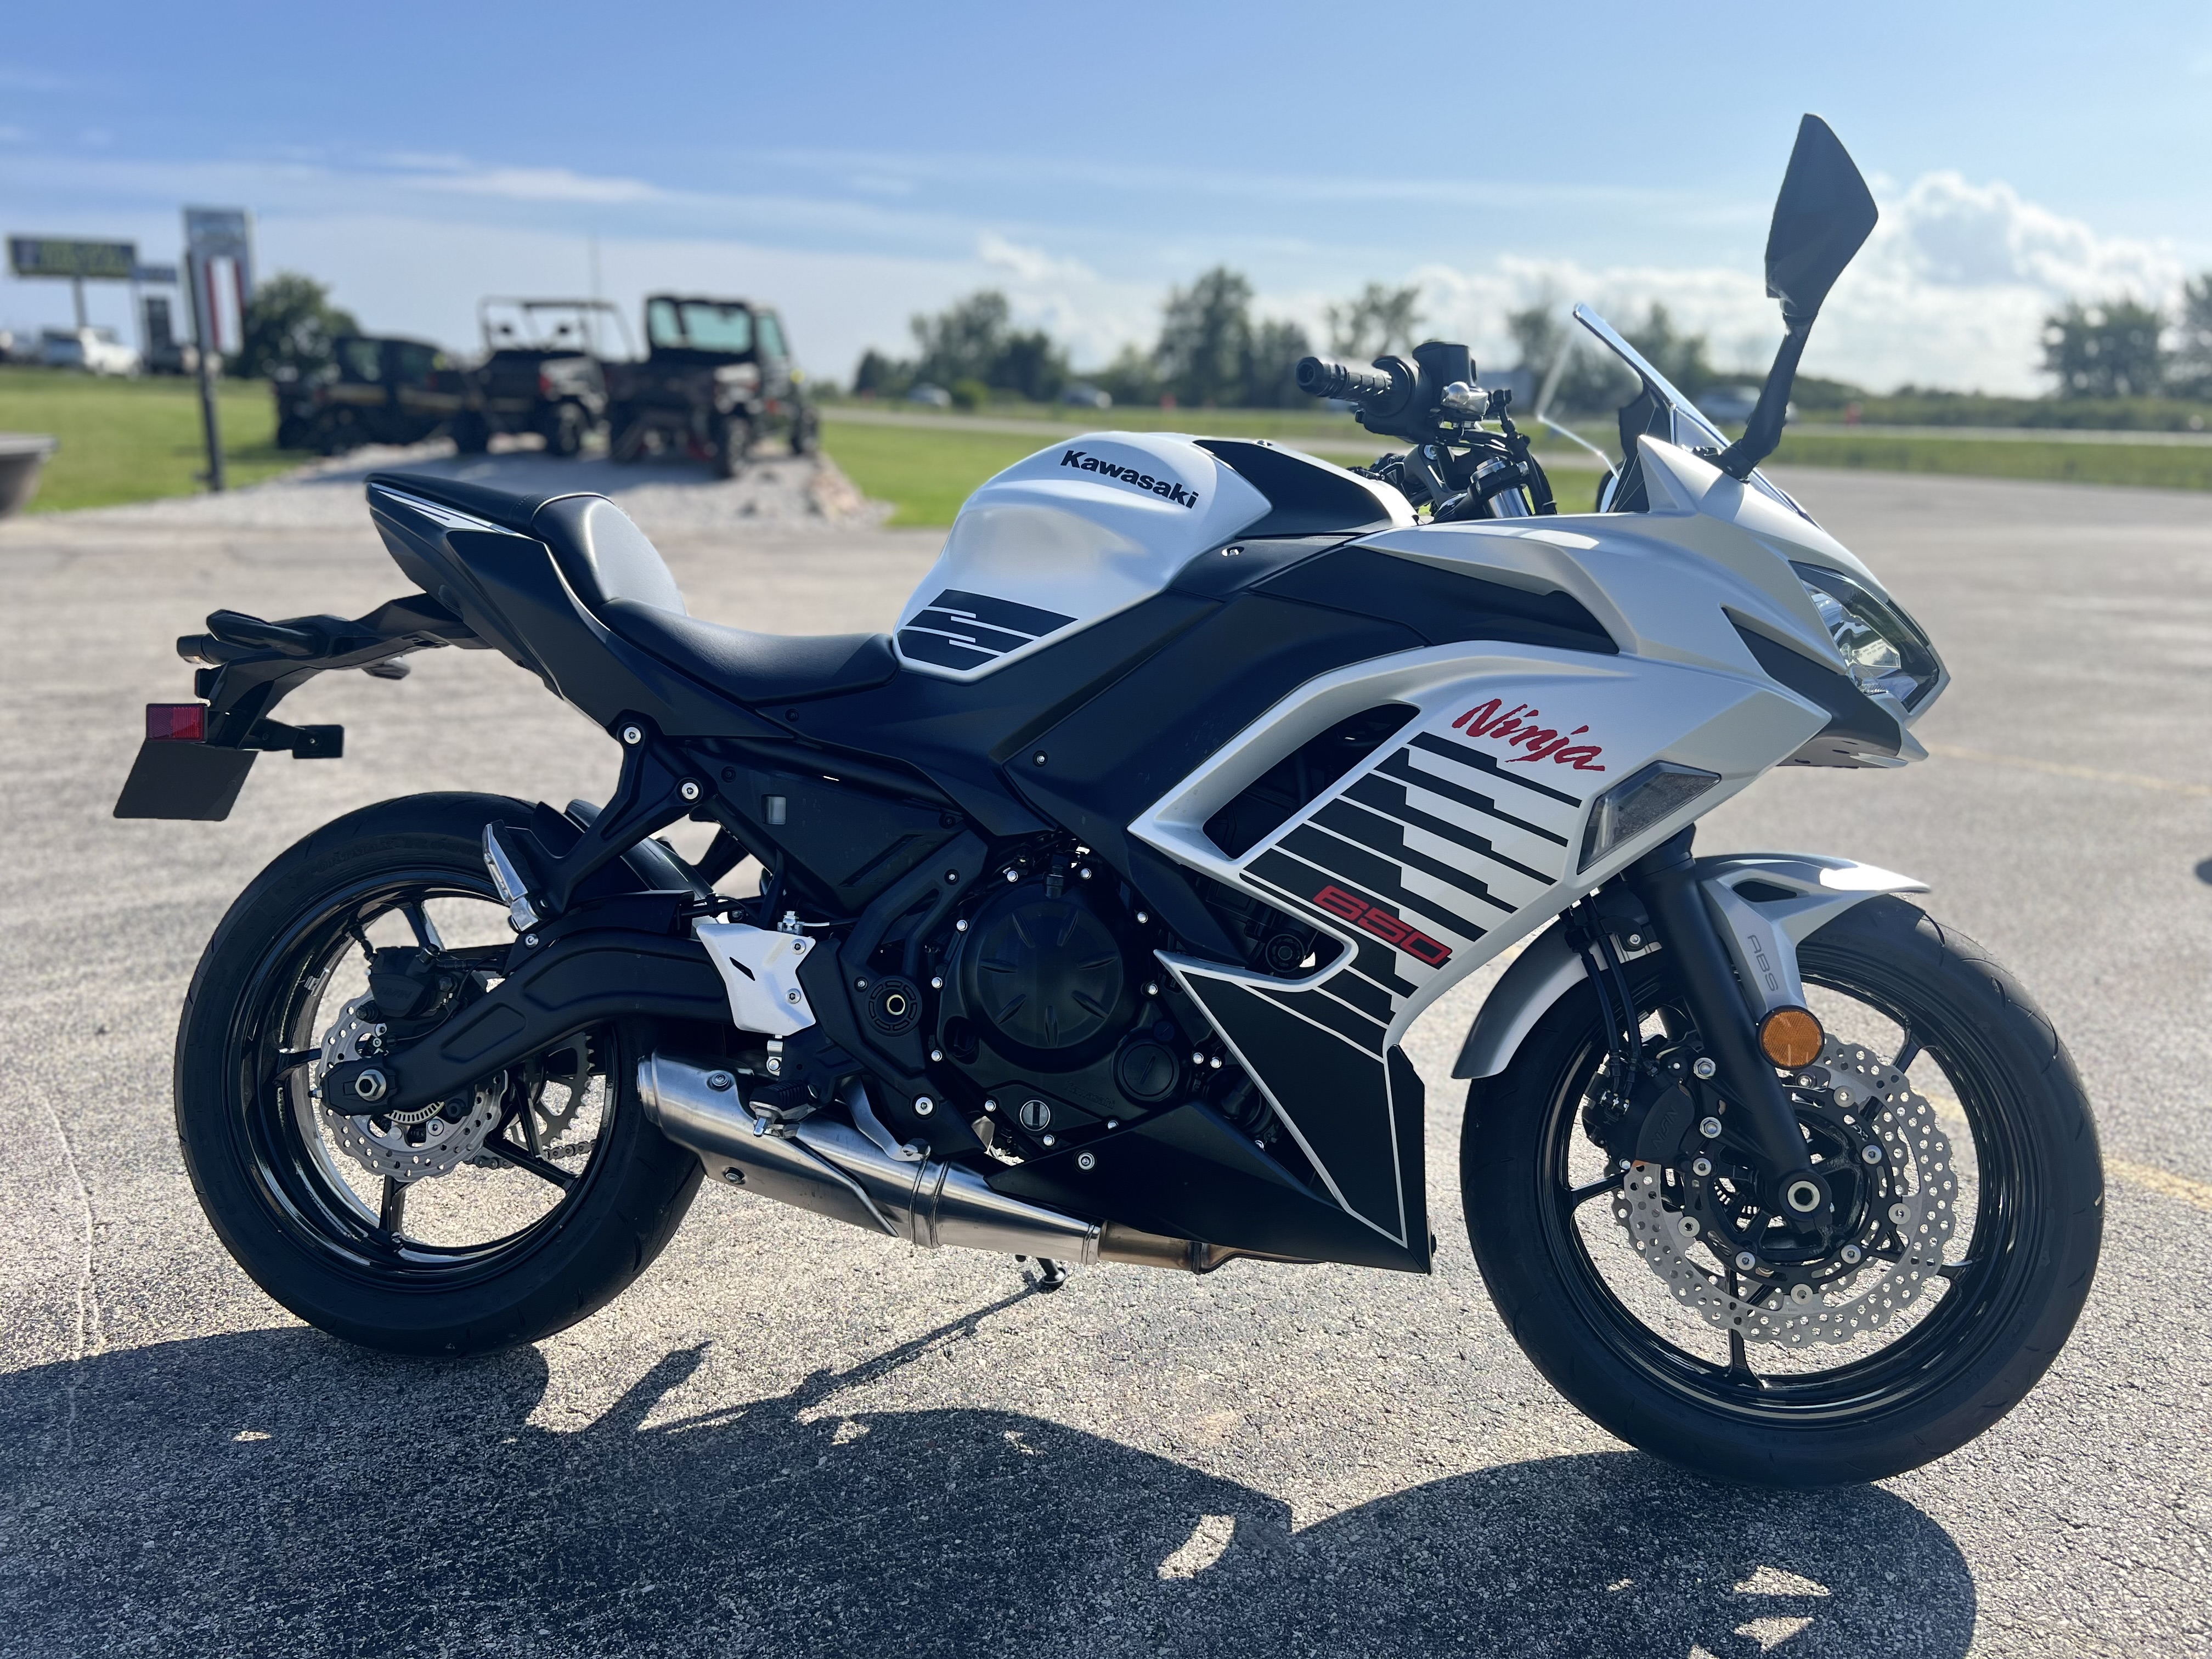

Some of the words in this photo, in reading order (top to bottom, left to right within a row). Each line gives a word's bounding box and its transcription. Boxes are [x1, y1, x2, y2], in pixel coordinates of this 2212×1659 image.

[1060, 450, 1200, 509] Kawasaki
[1451, 698, 1606, 771] Ninja
[1312, 884, 1453, 964] 650
[1747, 934, 1779, 991] ABS
